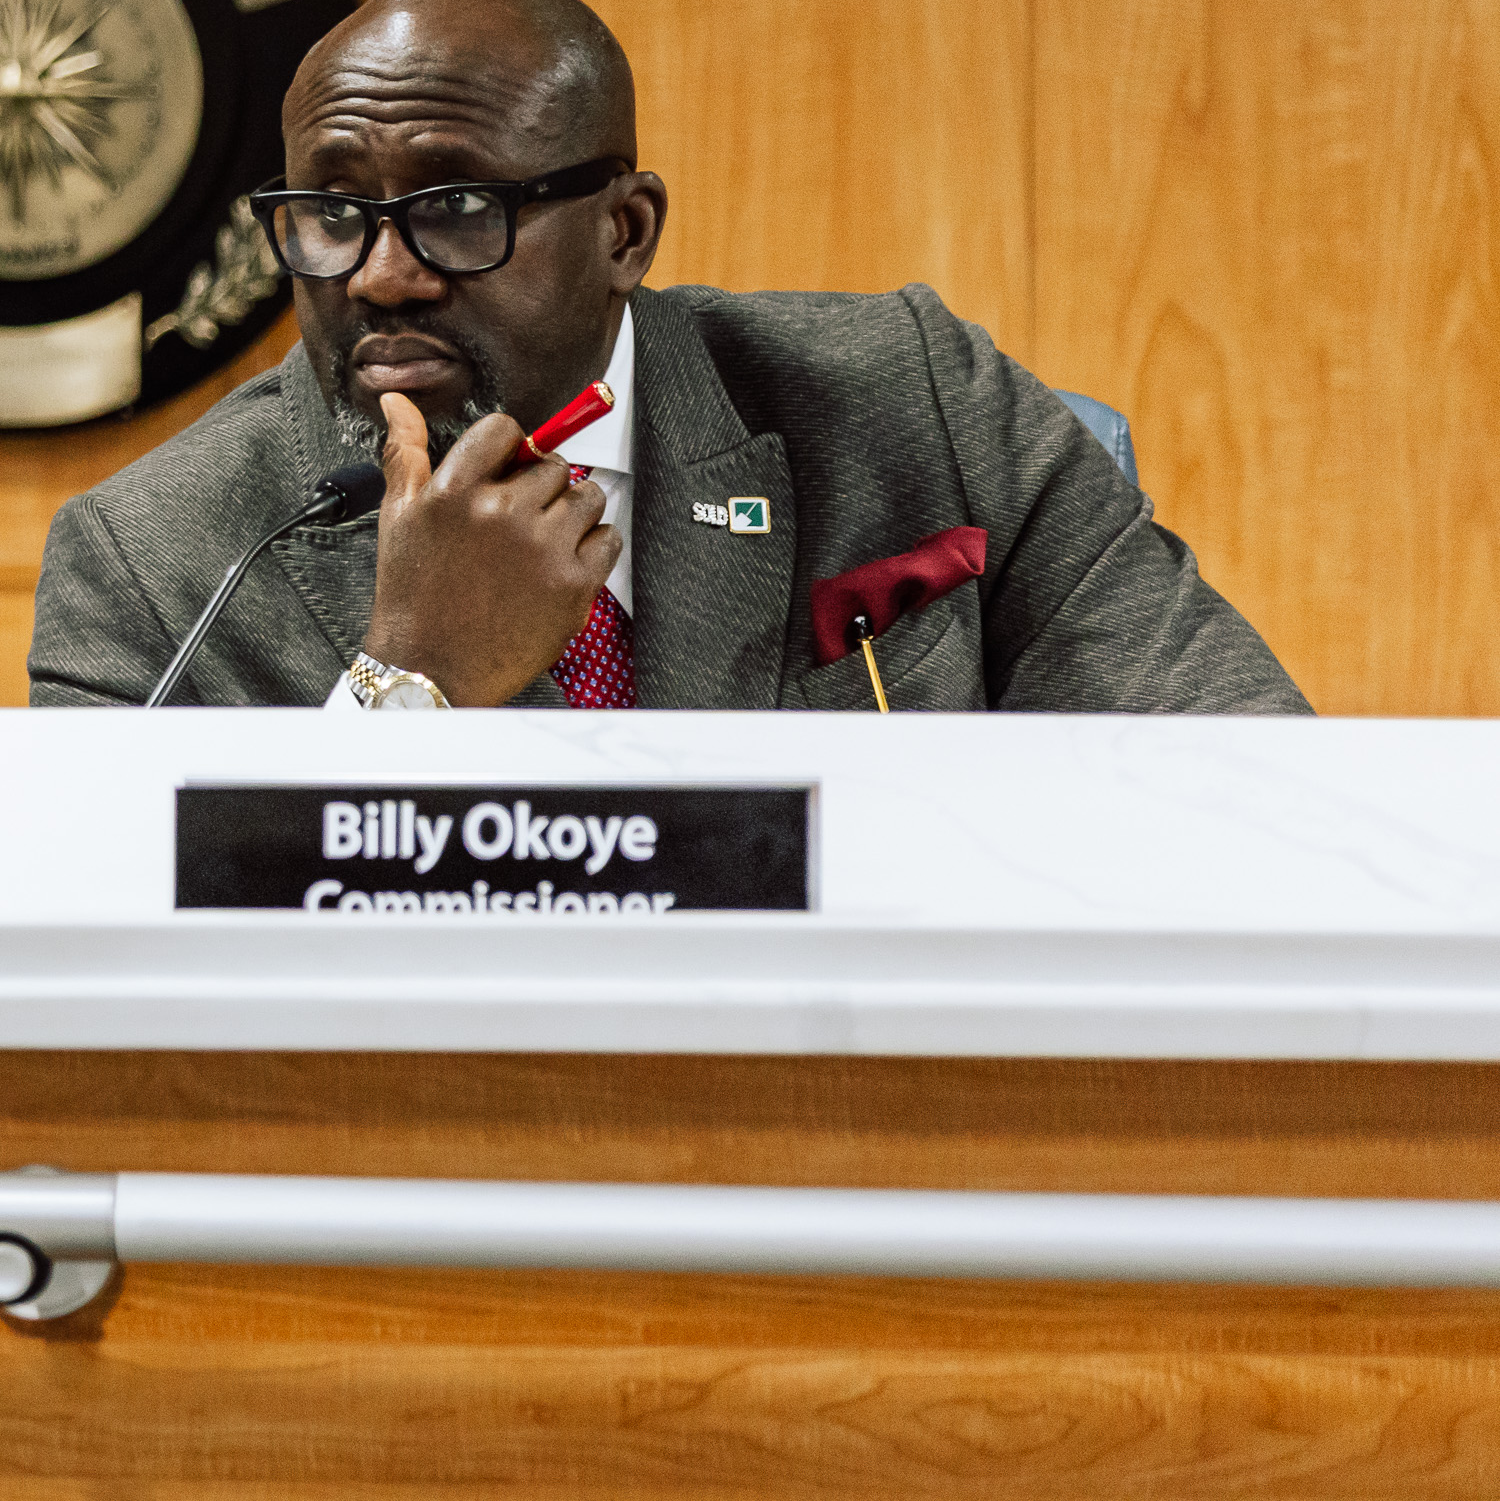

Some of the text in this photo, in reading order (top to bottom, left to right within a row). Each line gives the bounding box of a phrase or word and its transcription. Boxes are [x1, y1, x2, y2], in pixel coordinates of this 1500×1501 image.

[322, 800, 659, 875] Billy Okoye
[303, 879, 676, 912] Commissioner
